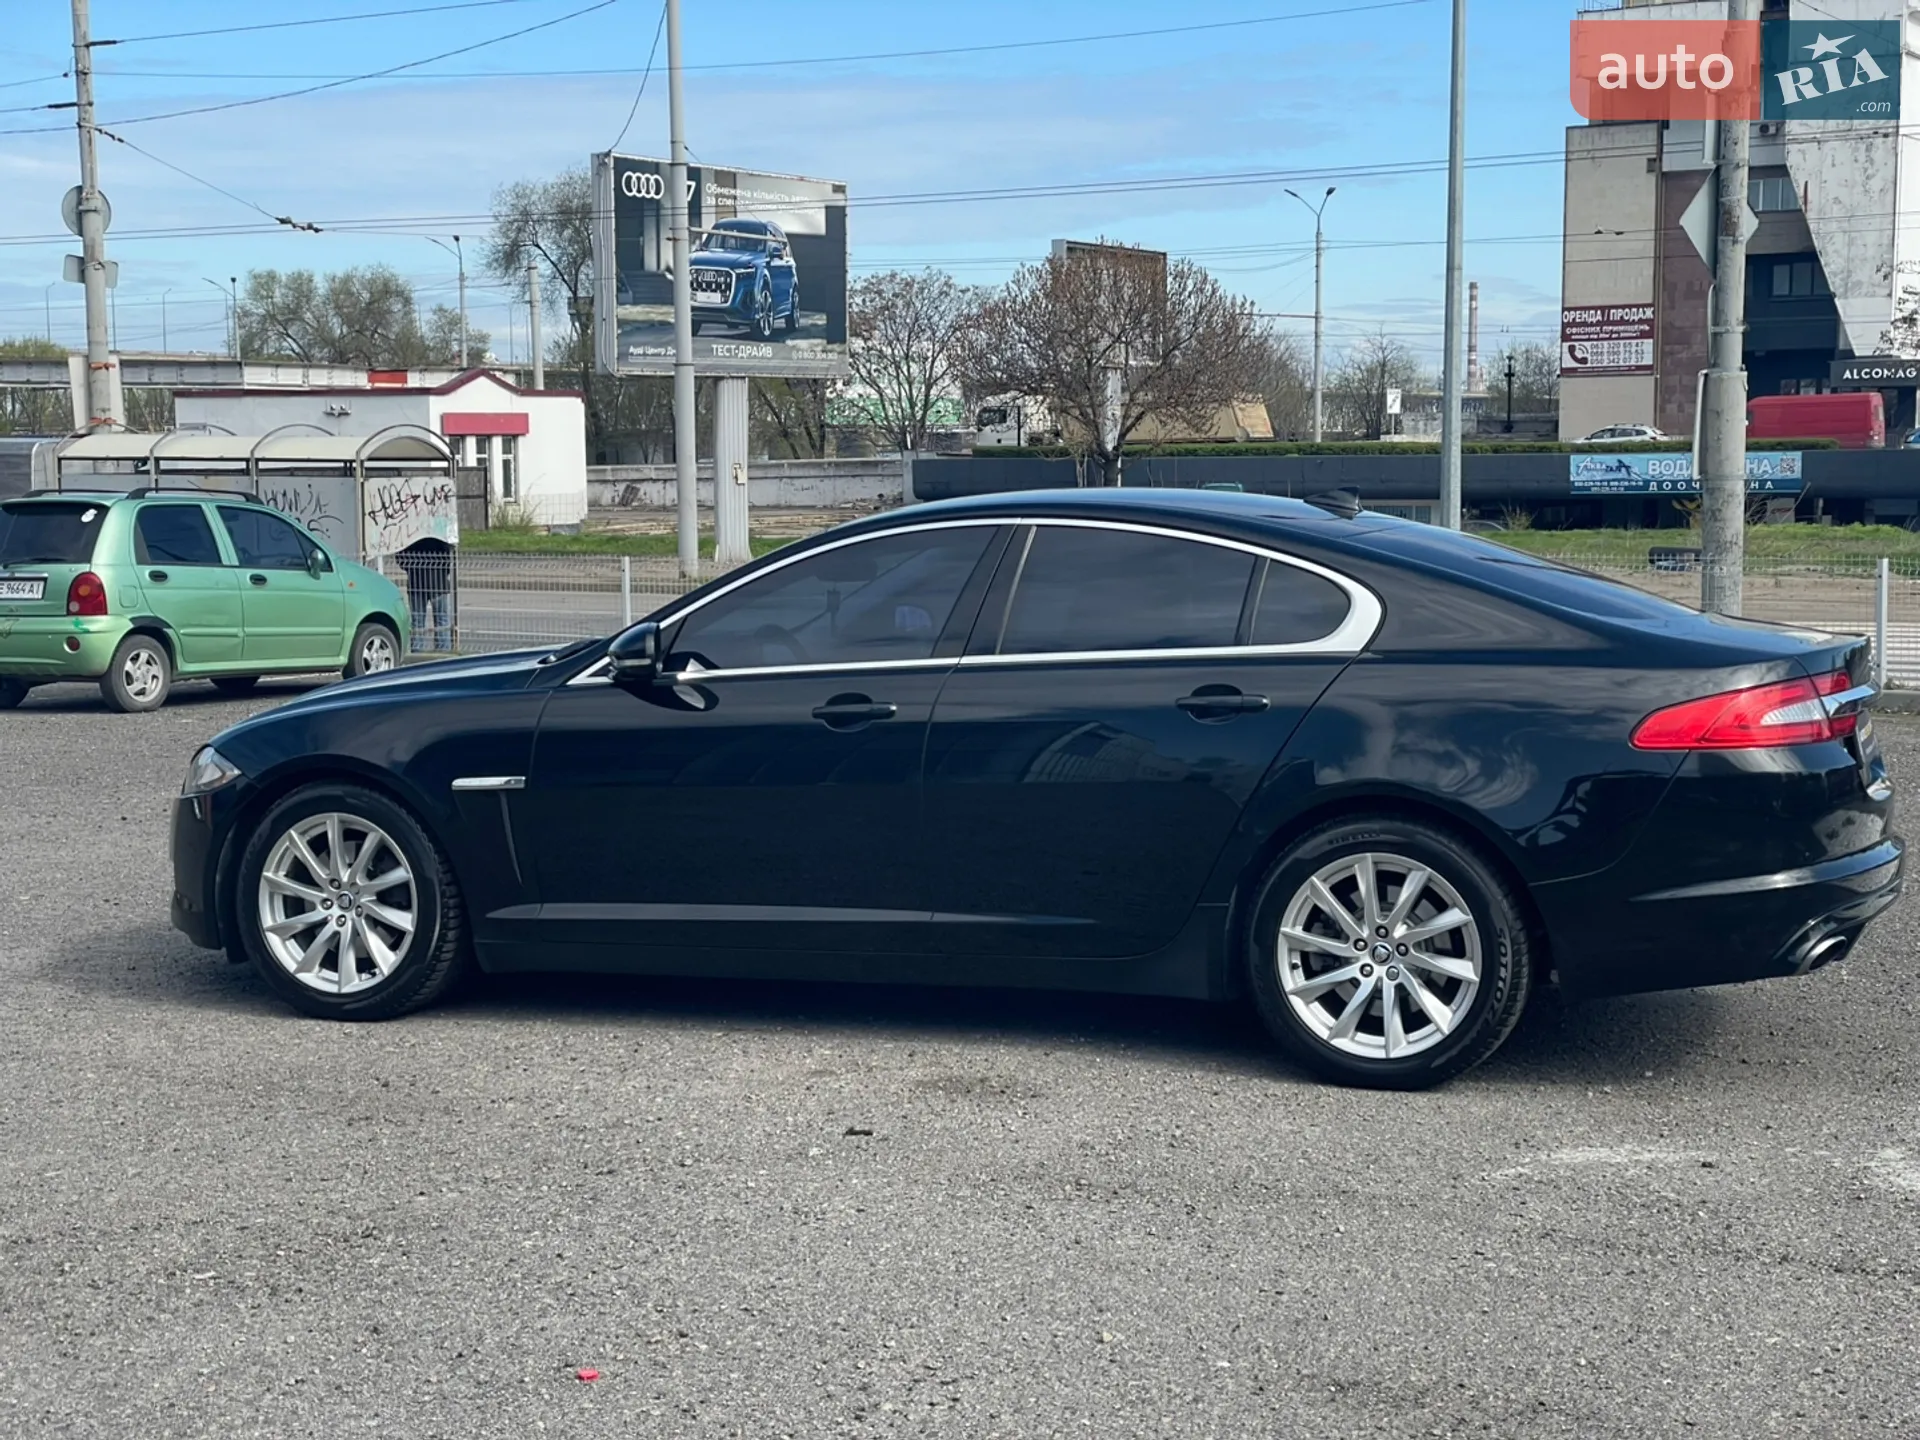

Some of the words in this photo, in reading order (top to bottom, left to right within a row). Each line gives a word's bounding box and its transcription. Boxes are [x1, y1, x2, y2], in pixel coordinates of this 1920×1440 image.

[705, 183, 752, 197] Обмежена
[1562, 309, 1603, 323] ОРЕНДА
[1604, 309, 1608, 321] /
[1609, 307, 1654, 322] ПРОДАЖ
[1566, 326, 1601, 334] ОФІСНИХ
[711, 344, 773, 359] ТЕСТ-ДРАЙВ
[6, 582, 27, 595] 9664
